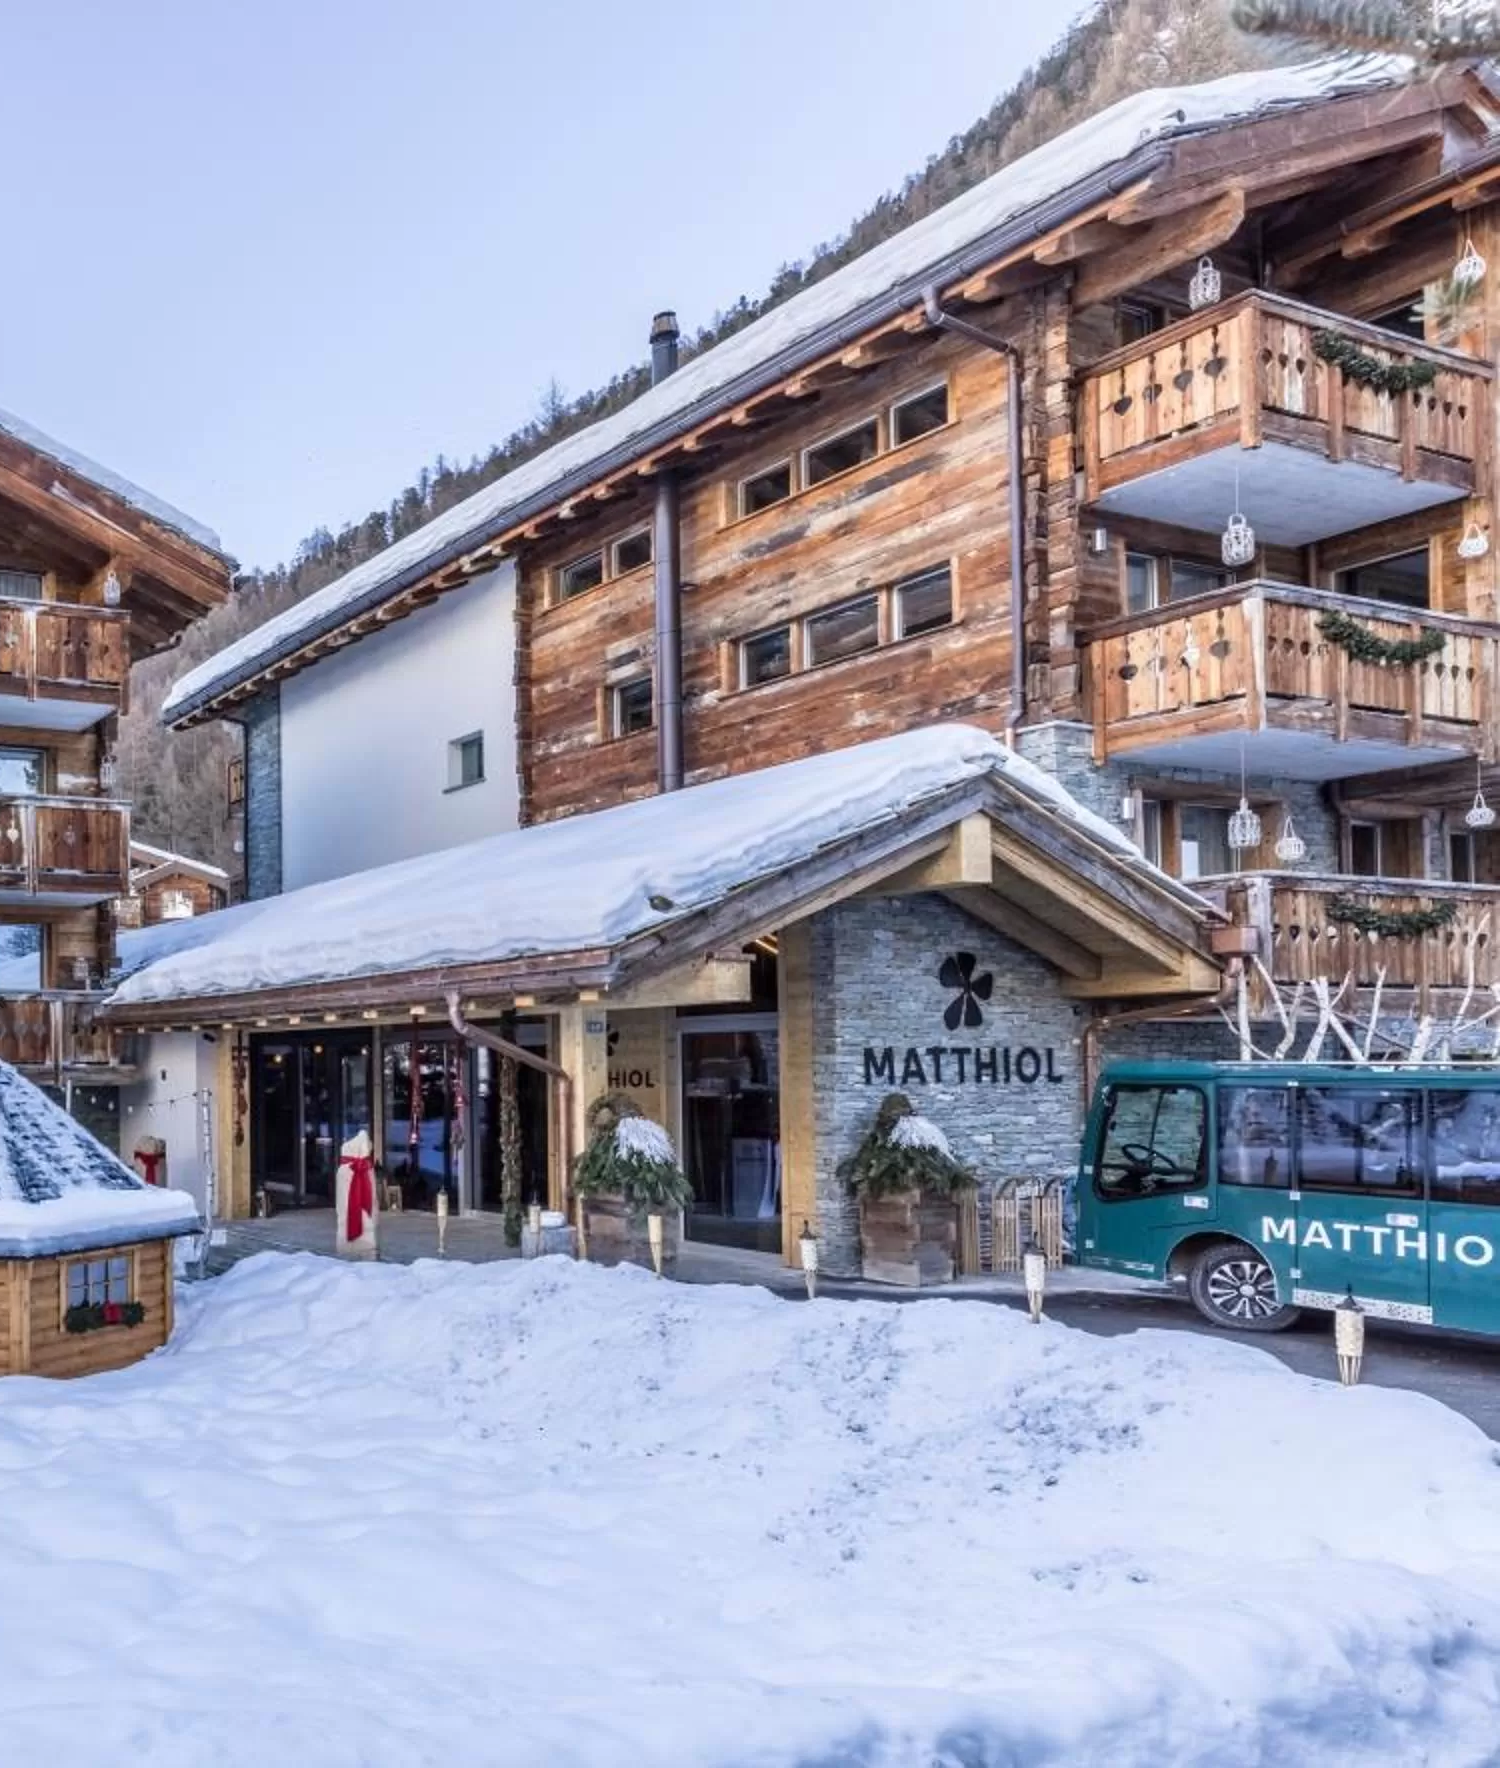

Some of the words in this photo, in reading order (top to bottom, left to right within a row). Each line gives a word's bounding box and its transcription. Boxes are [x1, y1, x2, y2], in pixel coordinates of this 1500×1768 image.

[608, 1069, 655, 1088] HIOL
[864, 1047, 1063, 1085] MATTHIOL
[1261, 1216, 1494, 1266] MATTHIO
